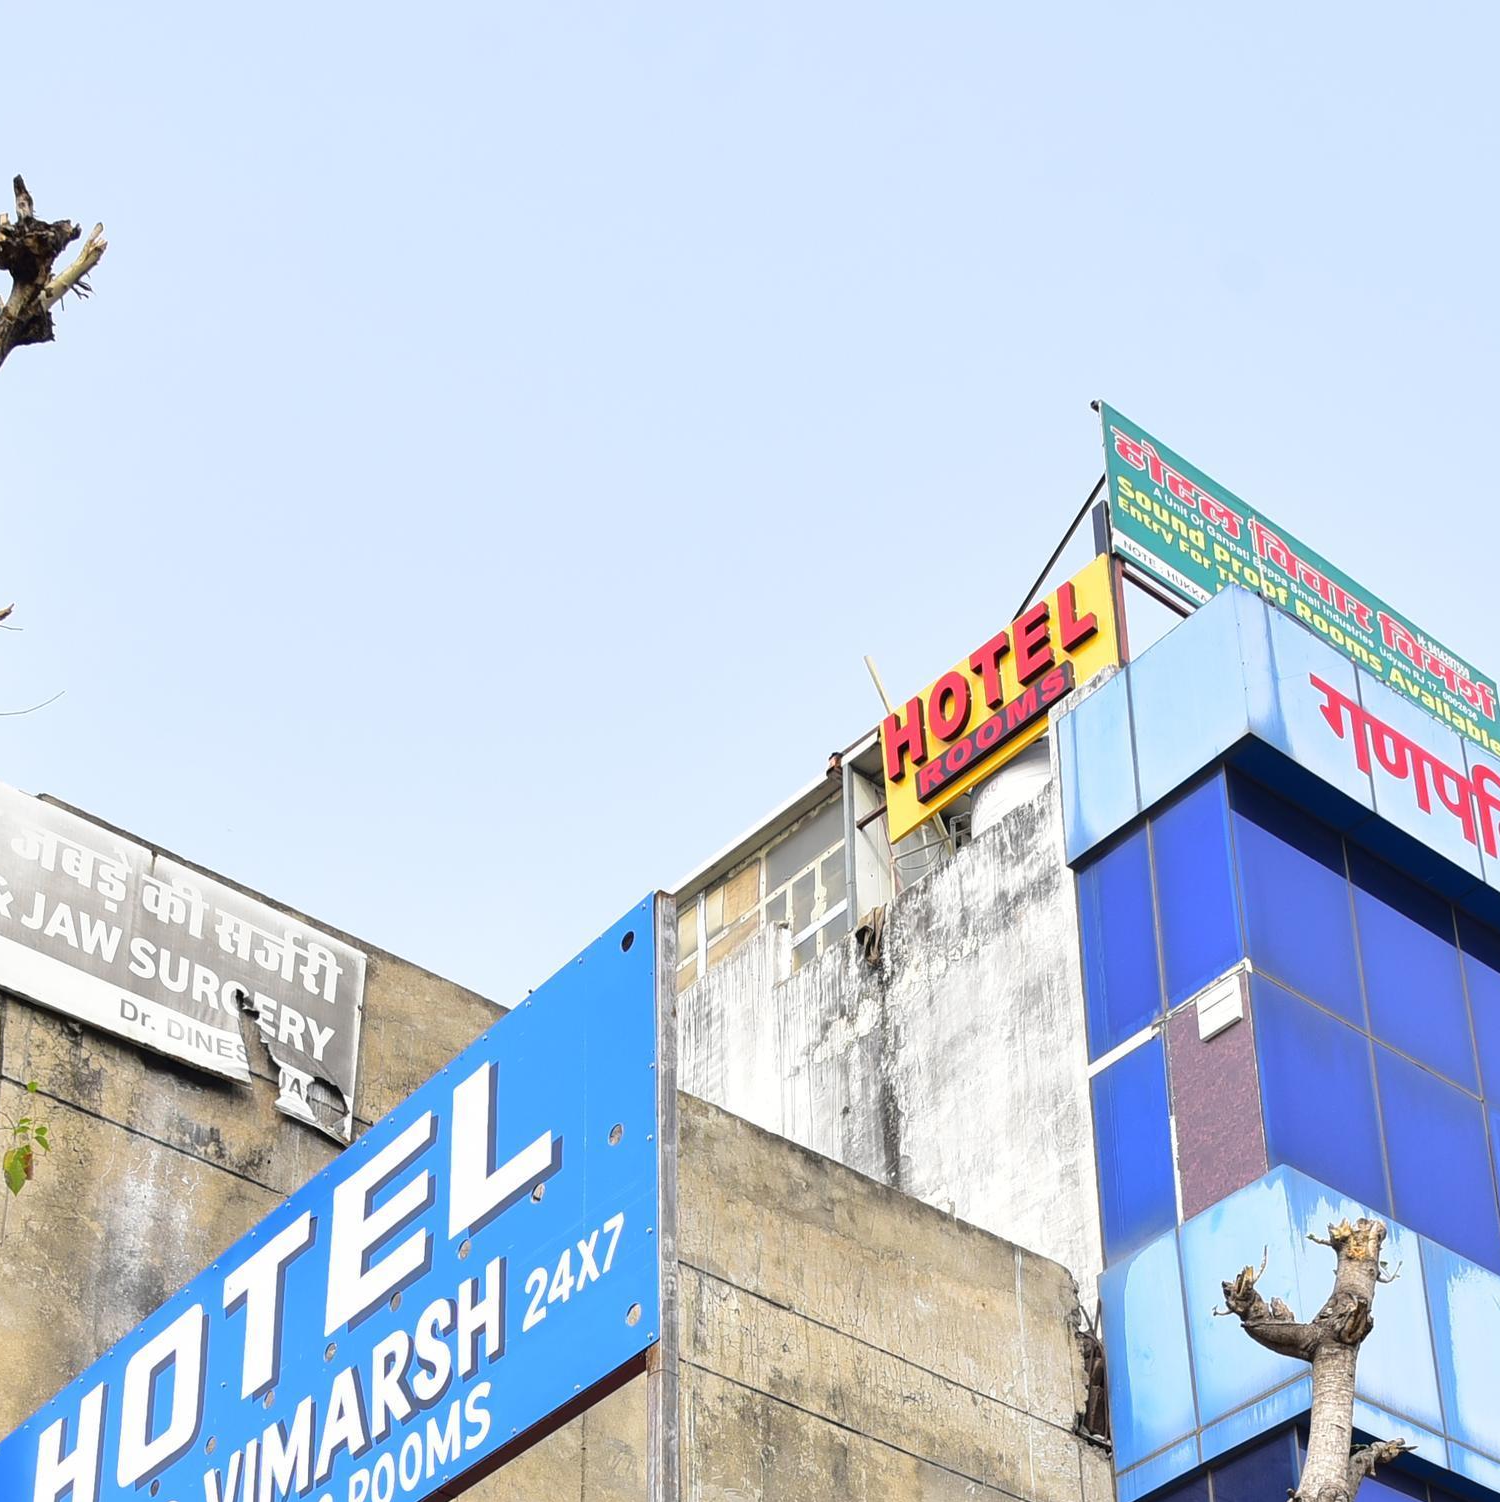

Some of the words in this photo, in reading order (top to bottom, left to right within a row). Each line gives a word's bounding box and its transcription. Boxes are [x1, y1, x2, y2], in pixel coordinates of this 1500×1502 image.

[1110, 424, 1244, 540] होटल
[1248, 517, 1374, 634] विचार
[1376, 610, 1497, 722] विमर्श
[1116, 495, 1175, 545] Entry
[1179, 538, 1212, 571] For
[1116, 474, 1206, 551] Sound
[1212, 542, 1289, 608] Proof
[1294, 598, 1384, 674] Rooms
[1153, 487, 1163, 500] A
[1165, 495, 1189, 518] Unit
[1191, 511, 1205, 529] Of
[1207, 524, 1251, 562] Ganpati
[1290, 582, 1321, 609] Small
[1322, 602, 1375, 649] Industries
[883, 580, 1099, 785] HOTEL
[919, 667, 1067, 796] ROOMS
[19, 891, 123, 964] JAW
[141, 873, 211, 940] की
[213, 906, 344, 1005] सर्जरी
[119, 998, 156, 1031] Dr.
[521, 1213, 627, 1333] 24X7
